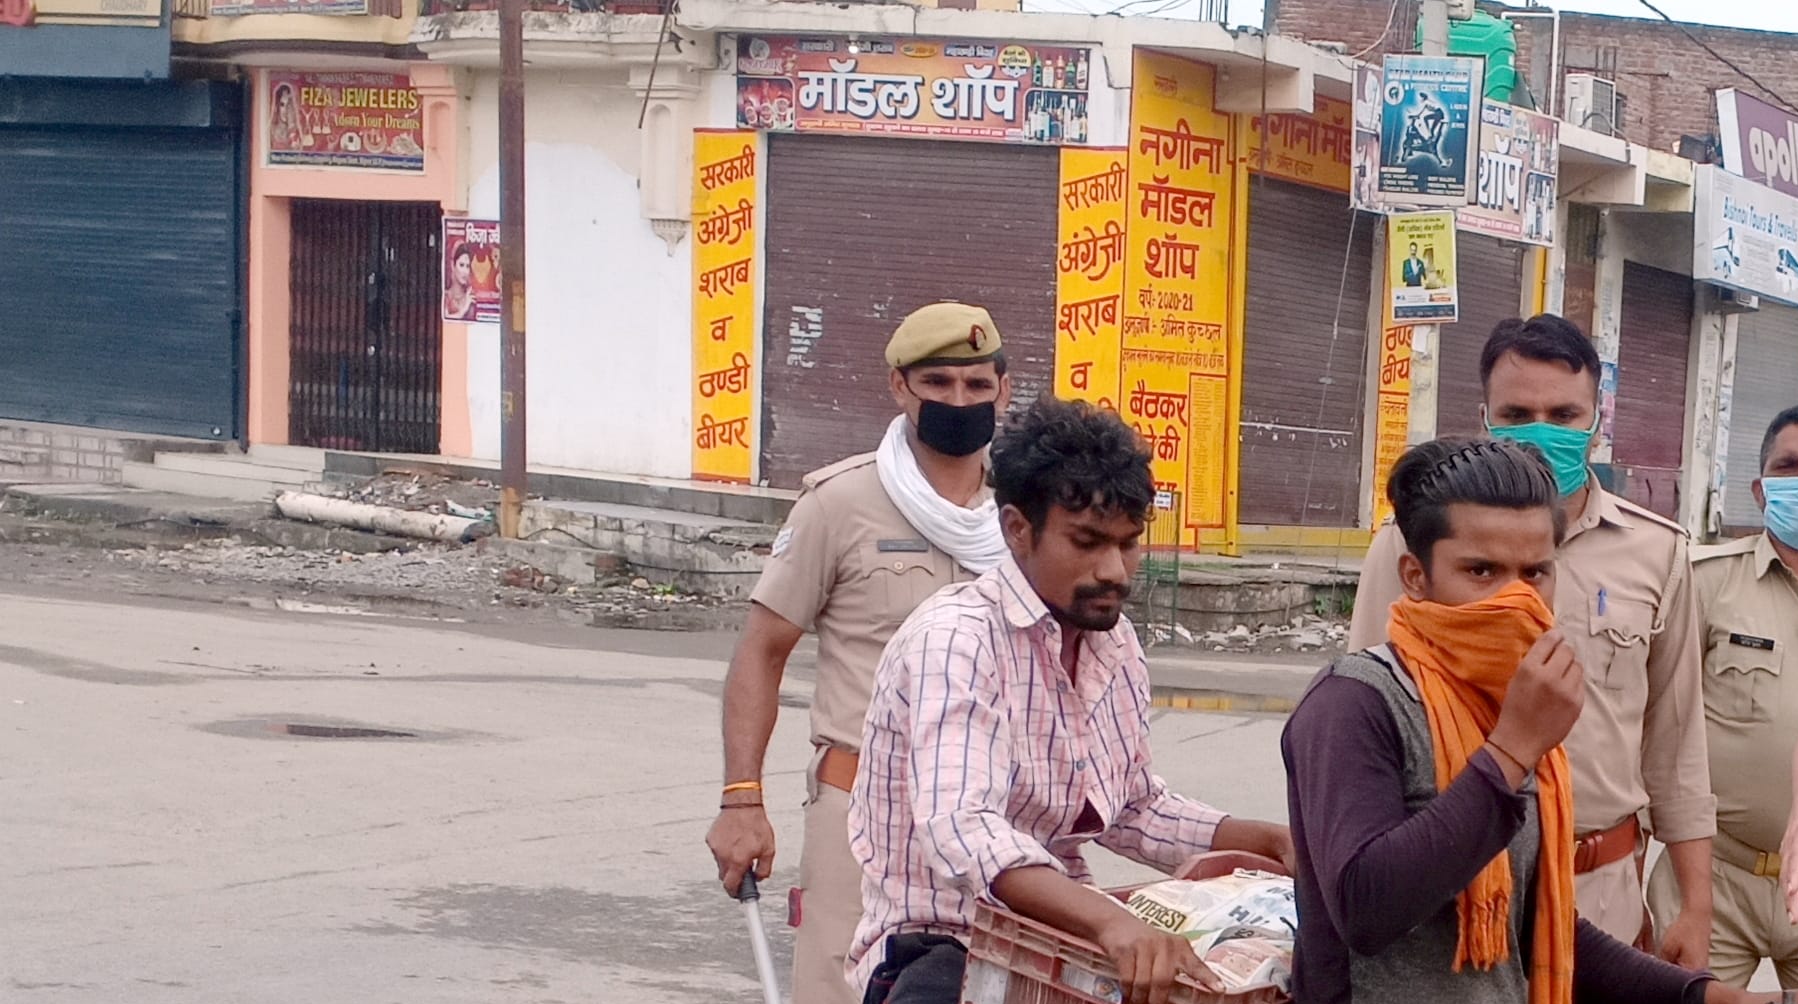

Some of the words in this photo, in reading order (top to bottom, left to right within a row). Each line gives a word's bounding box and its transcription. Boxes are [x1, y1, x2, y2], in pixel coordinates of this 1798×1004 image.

[300, 87, 333, 107] FIZA
[338, 87, 419, 110] JEWELERS
[798, 58, 925, 119] मॉडल
[932, 64, 1020, 122] शॉप
[361, 112, 383, 128] Your
[385, 113, 421, 129] Dreams
[1140, 118, 1225, 175] नगीना
[700, 144, 755, 190] सरकारी
[1063, 161, 1126, 212] सरकारी
[1138, 173, 1216, 228] मॉडल
[1749, 204, 1767, 232] Tours
[697, 198, 752, 246] अंग्रेजी
[1060, 220, 1127, 281] अंग्रेजी
[1144, 232, 1200, 280] शॉप
[699, 258, 751, 297] शराब
[1058, 294, 1120, 342] शराब
[1158, 291, 1194, 312] 2020-21
[711, 316, 734, 343] व
[1385, 325, 1413, 352] ठण्ड
[699, 352, 751, 399] ठण्डी
[1070, 361, 1093, 391] व
[1382, 353, 1410, 385] बीय
[1130, 379, 1188, 428] बैठकर
[697, 414, 750, 450] बीयर
[1157, 425, 1181, 461] की
[1128, 894, 1187, 932] INTEREST
